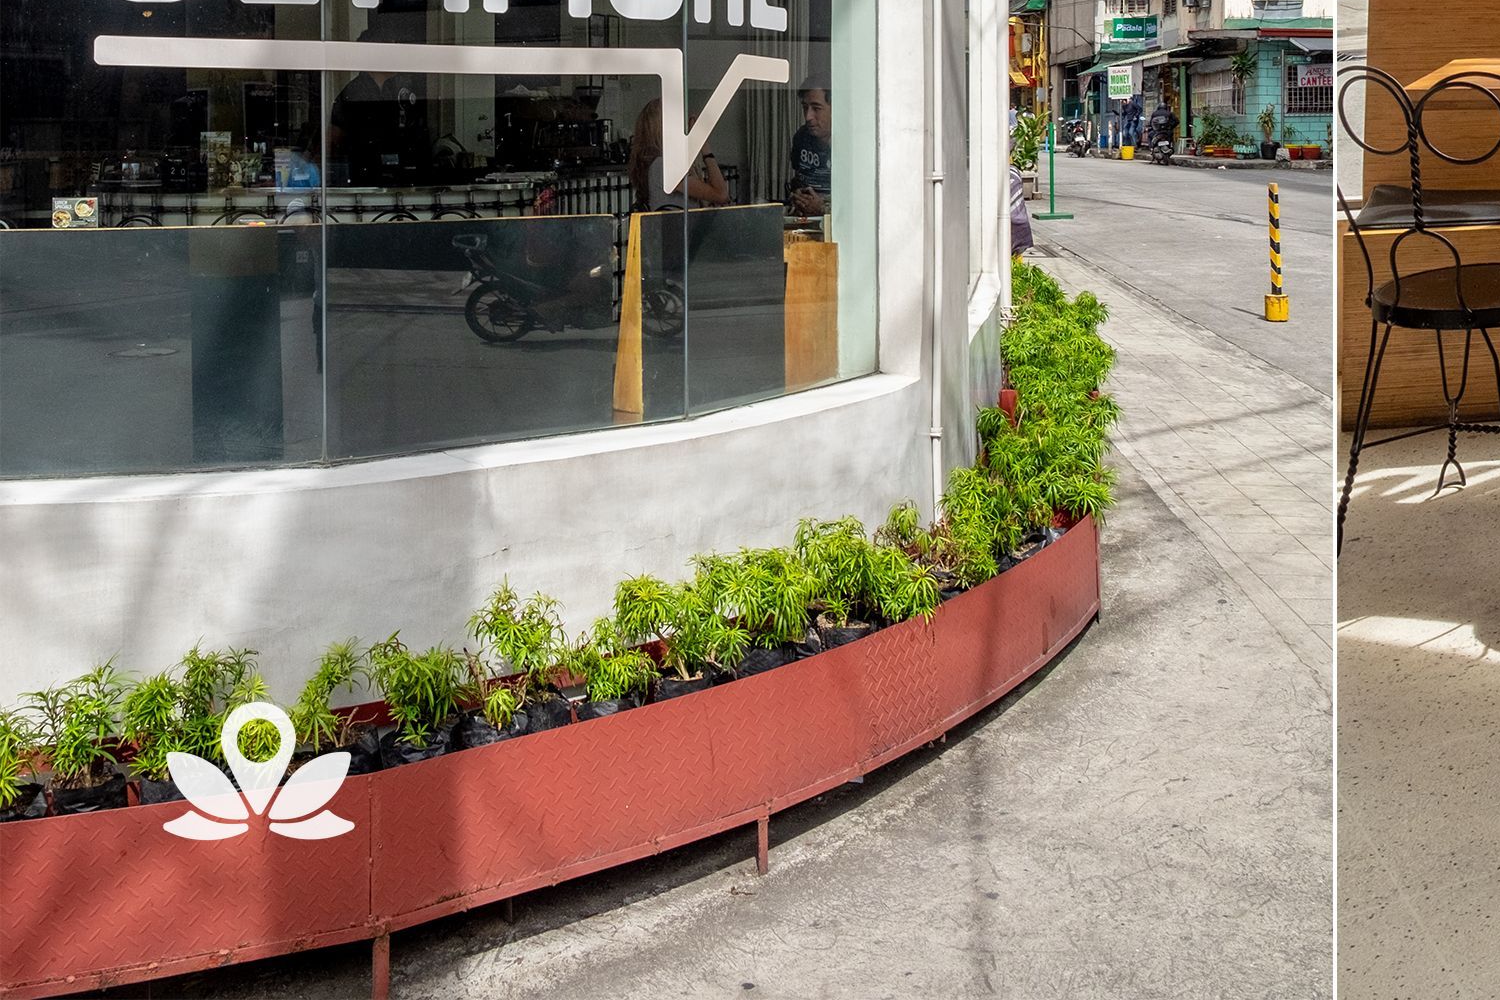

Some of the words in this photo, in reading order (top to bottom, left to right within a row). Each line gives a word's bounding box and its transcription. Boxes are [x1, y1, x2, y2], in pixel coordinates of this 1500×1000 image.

[1115, 23, 1143, 32] Padala
[1111, 75, 1129, 84] MONEY
[1300, 76, 1333, 86] CANTEE
[1110, 85, 1131, 95] CHANGER
